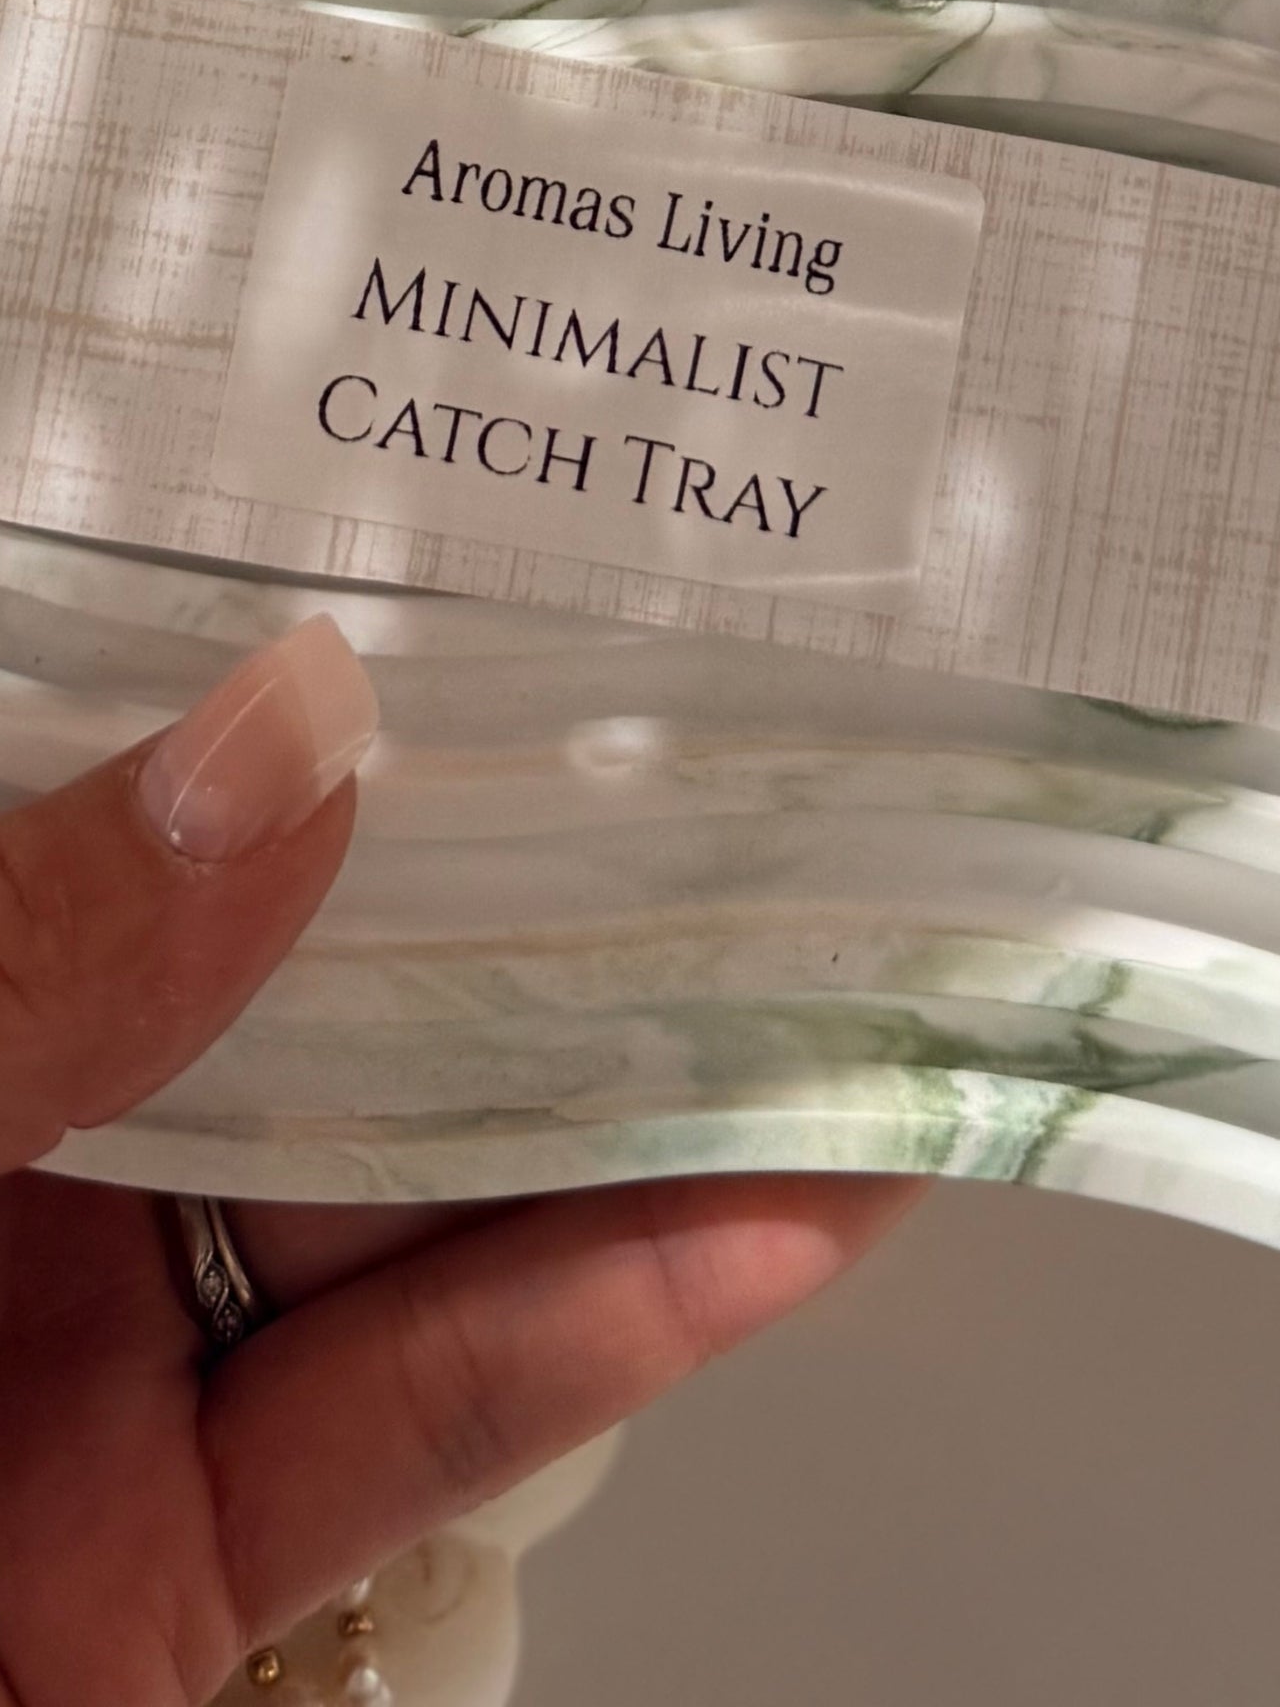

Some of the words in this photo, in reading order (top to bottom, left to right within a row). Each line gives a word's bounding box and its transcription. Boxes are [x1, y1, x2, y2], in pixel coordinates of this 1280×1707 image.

[400, 138, 636, 239] Aromas
[656, 191, 844, 296] Living
[350, 256, 845, 419] MINIMALIST
[317, 374, 598, 493] CATCH
[623, 434, 828, 539] TRAY
